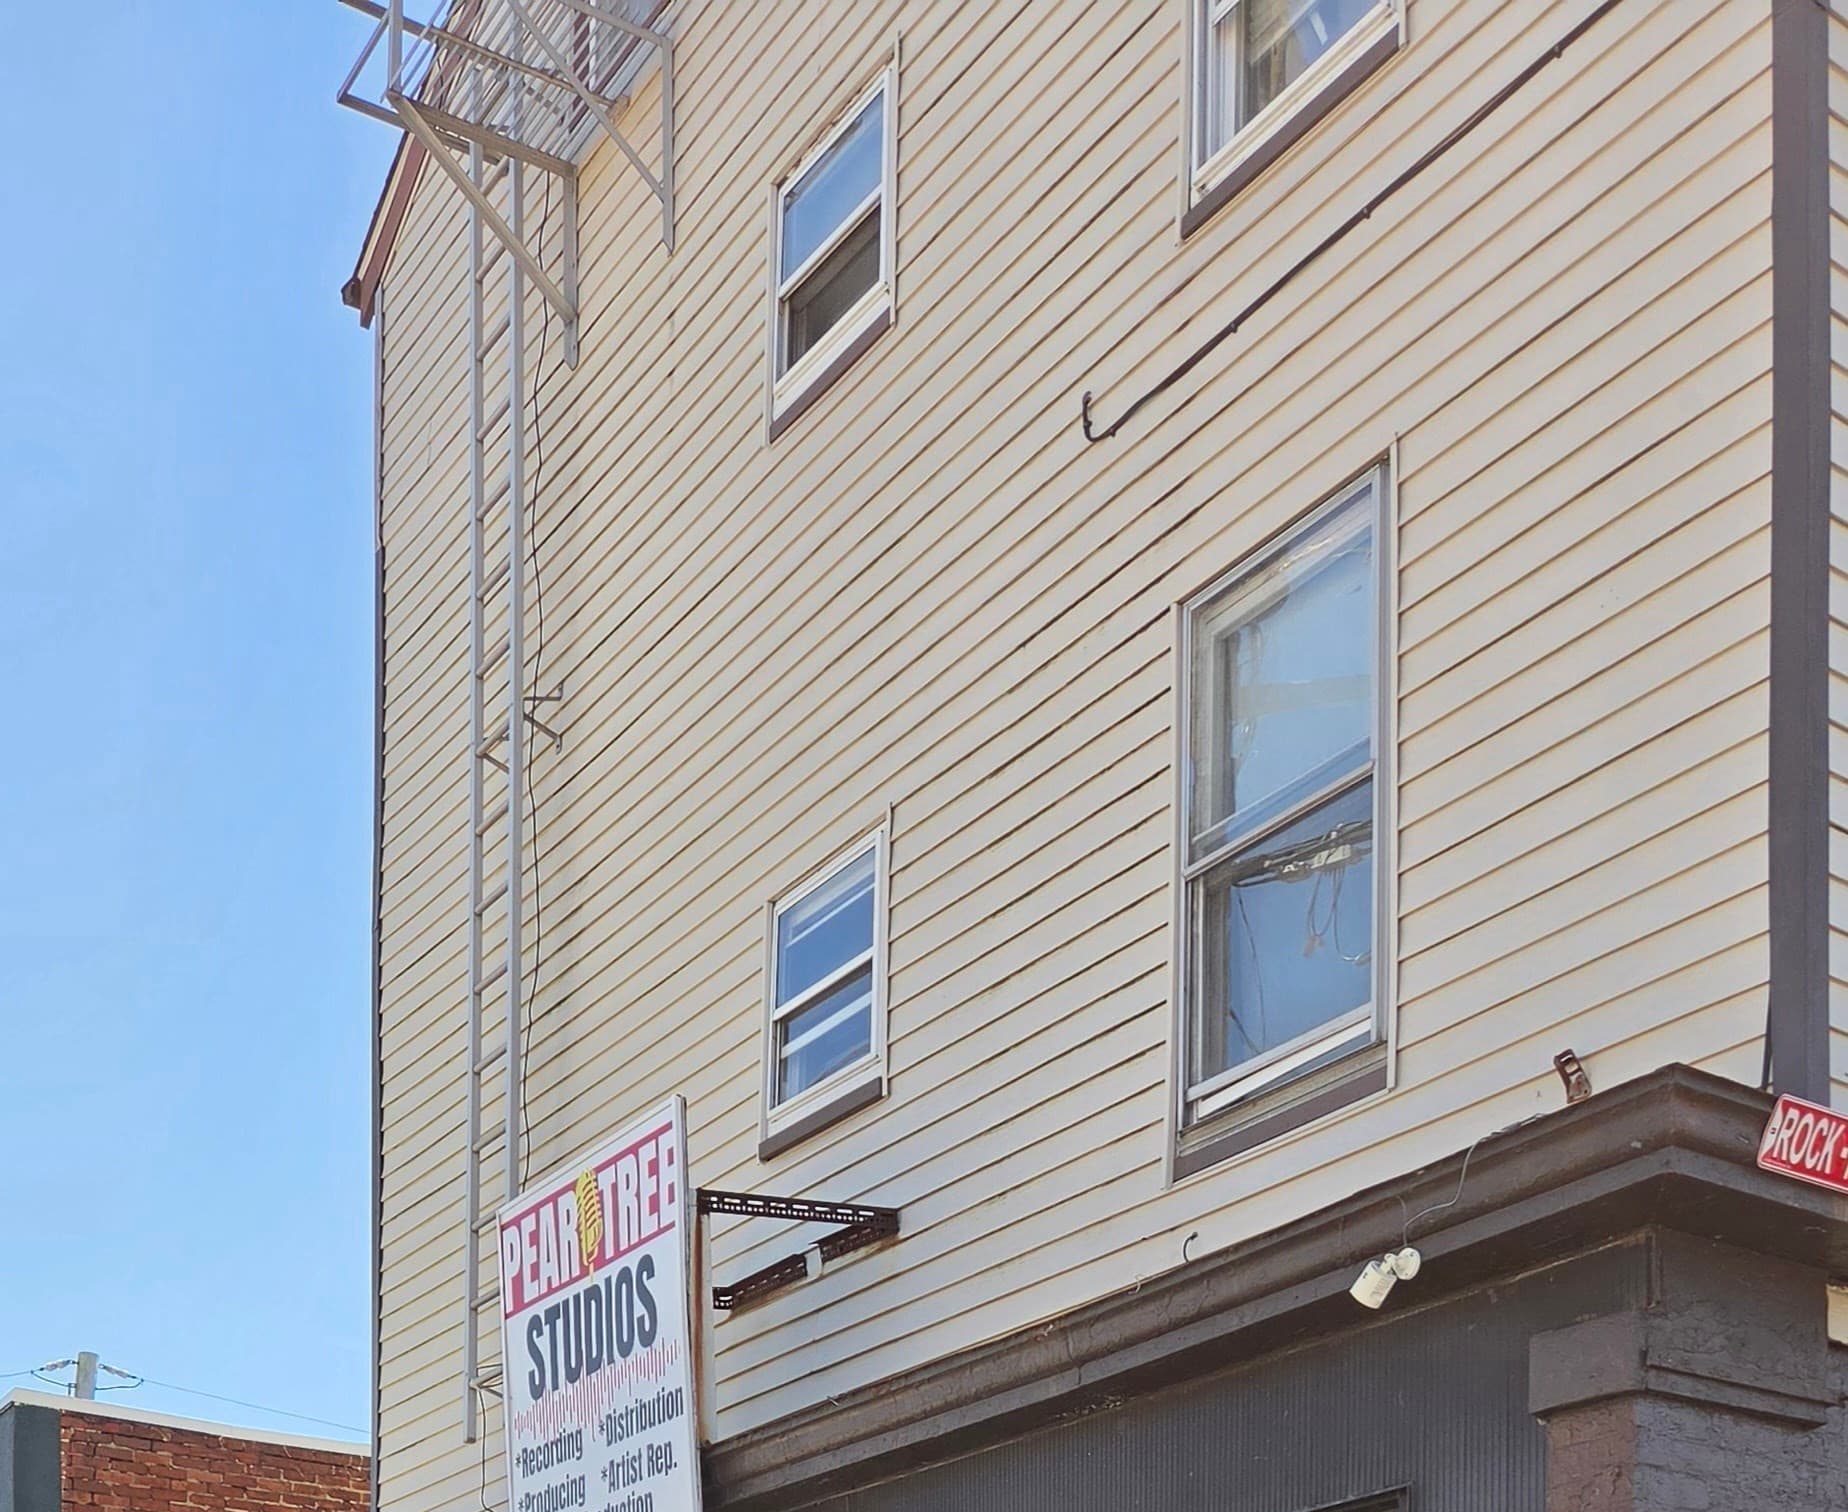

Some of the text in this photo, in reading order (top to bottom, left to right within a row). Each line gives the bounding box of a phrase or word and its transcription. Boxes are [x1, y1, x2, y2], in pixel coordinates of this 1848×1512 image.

[502, 1128, 676, 1314] PEAR TREE
[526, 1254, 658, 1401] STUDIOS
[647, 1440, 678, 1479] Rep.
